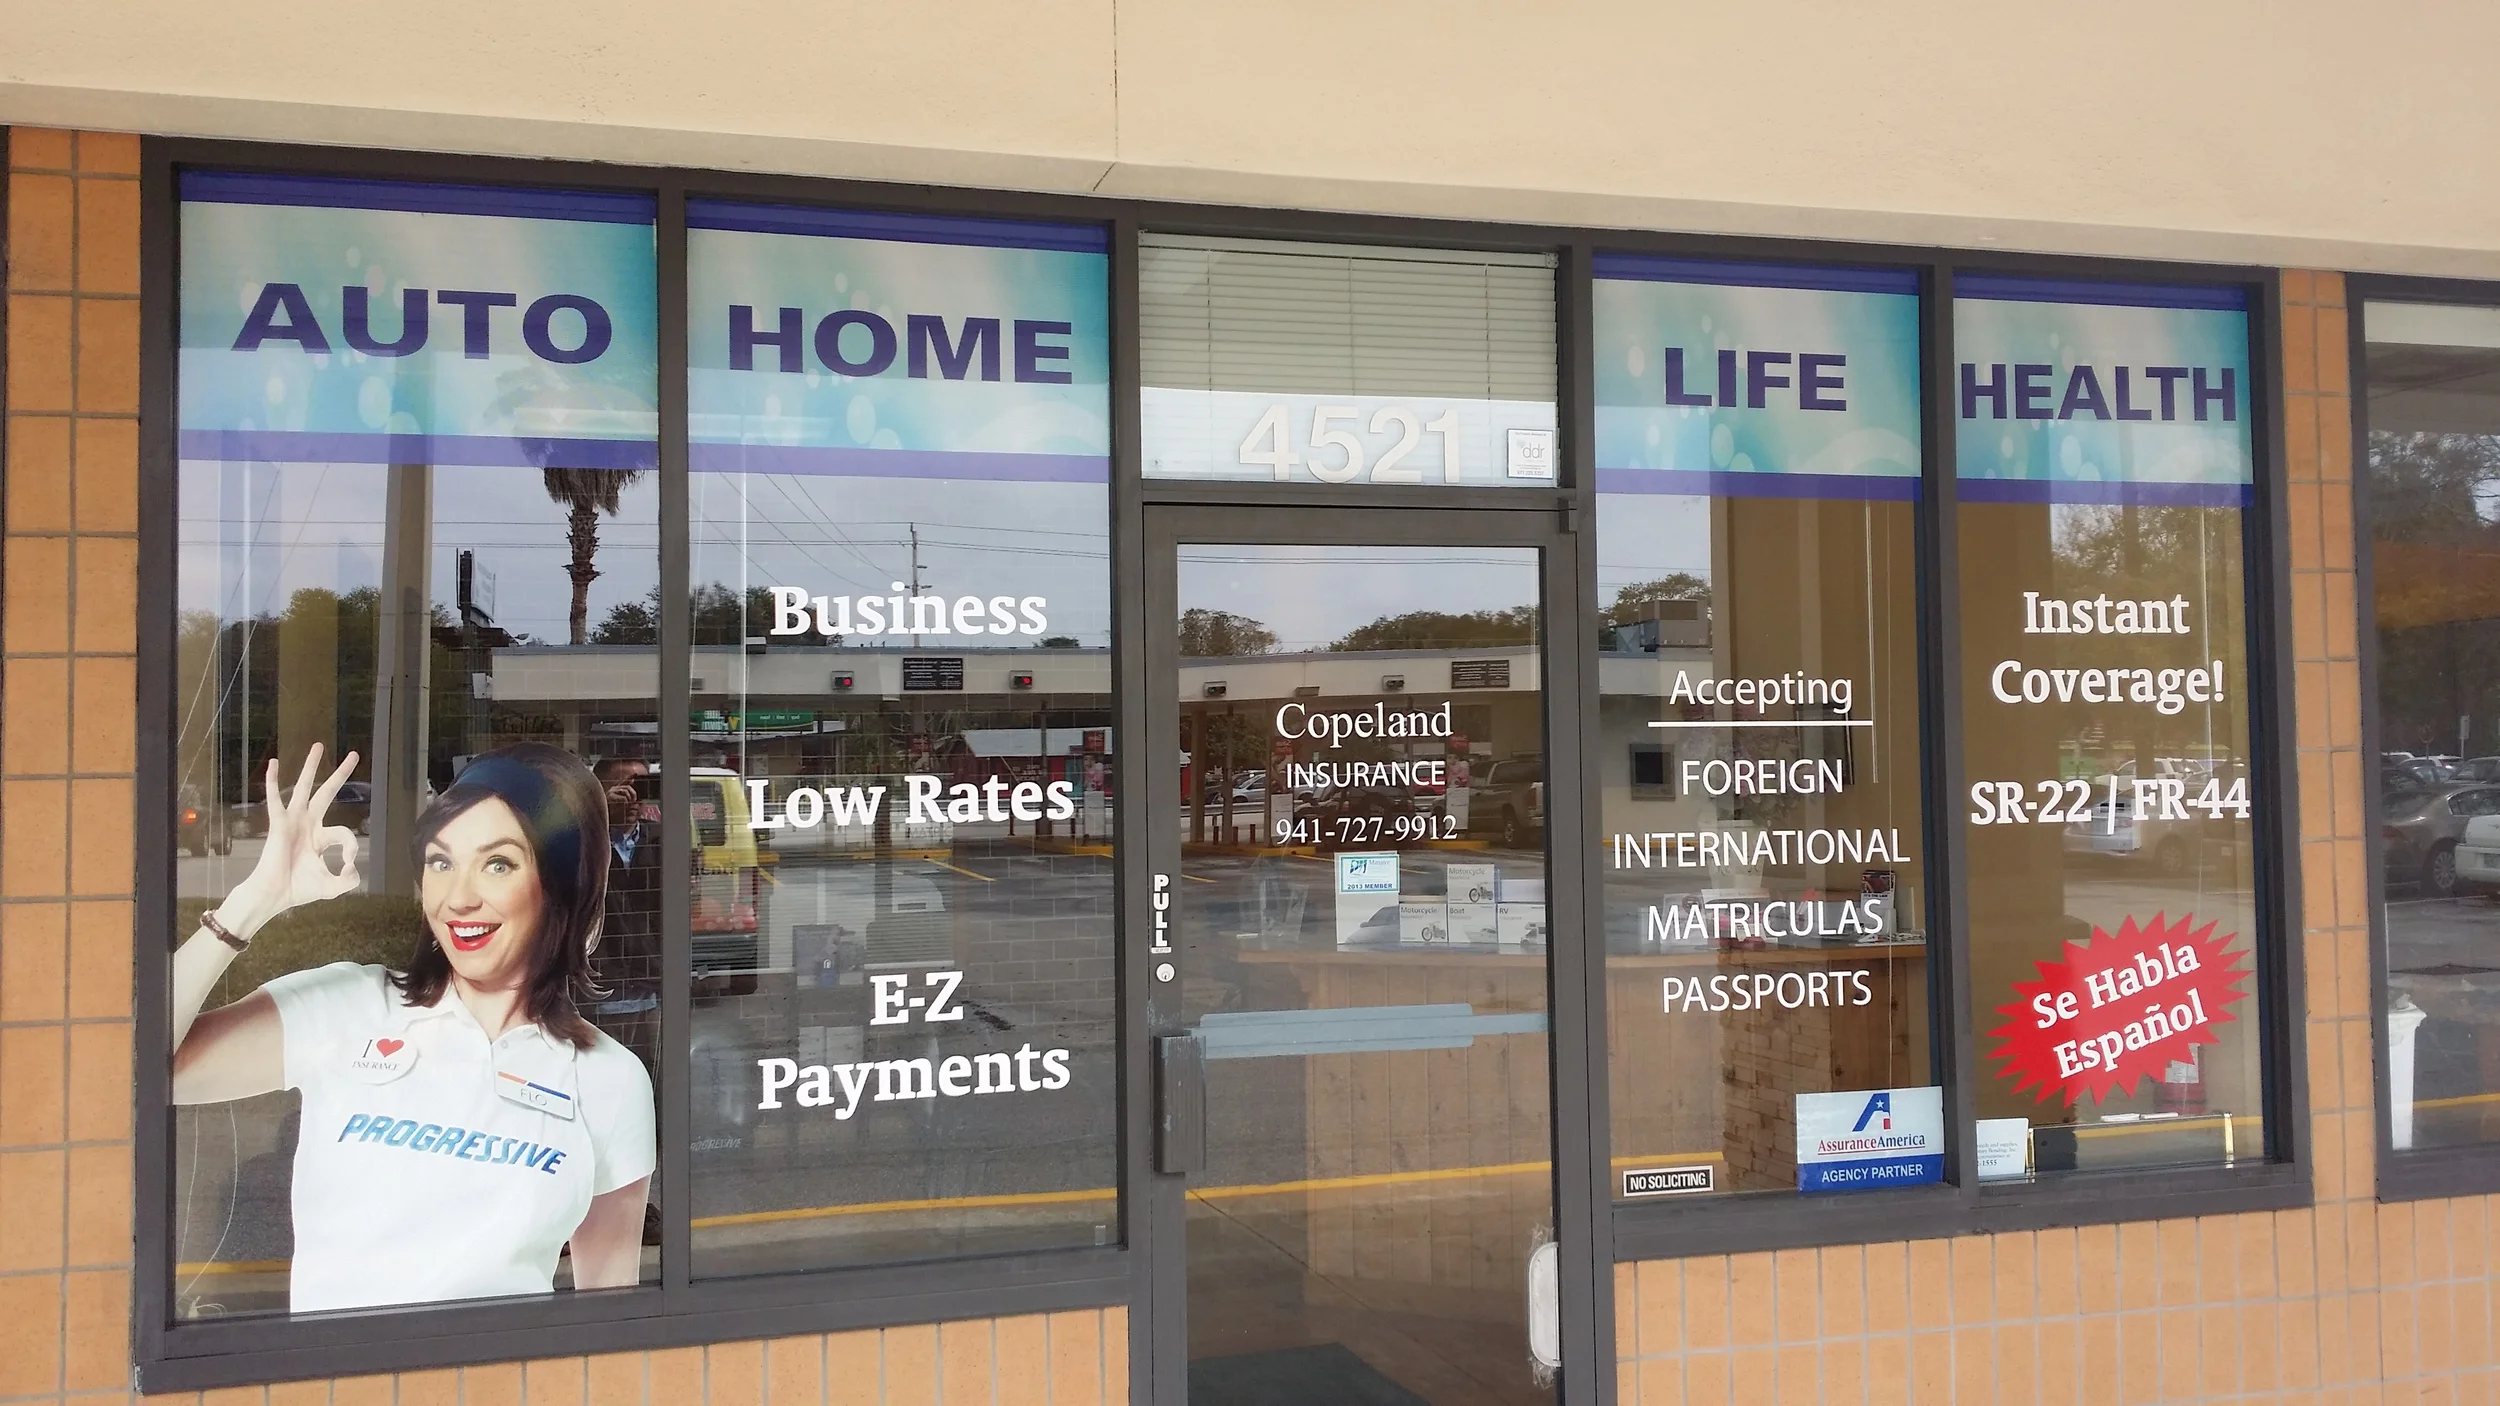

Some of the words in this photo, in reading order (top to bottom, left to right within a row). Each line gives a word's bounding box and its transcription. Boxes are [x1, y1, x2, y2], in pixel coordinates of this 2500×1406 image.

[231, 282, 613, 364] AUTO
[729, 304, 1073, 384] HOME
[1665, 347, 1847, 412] LIFE
[1960, 362, 2237, 422] HEALTH
[1239, 405, 1461, 484] 4521
[1522, 443, 1545, 458] ddr
[770, 581, 1048, 636] Business
[2023, 591, 2191, 634] Instant
[1669, 670, 1852, 714] Accepting
[1992, 660, 2225, 714] Coverage!
[1276, 701, 1454, 748] Copeland
[1286, 760, 1446, 788] INSURANCE
[1682, 758, 1843, 795] FOREIGN
[746, 779, 887, 829] Low
[904, 774, 1074, 824] Rates
[1971, 779, 2092, 825] SR-22
[2132, 777, 2251, 821] FR-44
[1276, 814, 1458, 845] 941-727-9912
[1614, 828, 1911, 869] INTERNATIONAL
[1448, 868, 1485, 876] Motorcycle
[1153, 874, 1170, 947] PULL
[1400, 907, 1438, 915] Motorcycle
[1647, 898, 1884, 941] MATRICULAS
[869, 970, 965, 1026] E-Z
[1662, 970, 1872, 1014] PASSPORTS
[2033, 992, 2080, 1029] Se
[2085, 942, 2201, 1009] Habla
[362, 1040, 373, 1058] I
[2053, 987, 2208, 1079] Español
[352, 1060, 401, 1072] INSURANCE
[757, 1042, 1072, 1121] Payments
[520, 1088, 548, 1107] FLO
[338, 1113, 567, 1176] PROGRESSIVE
[1818, 1134, 1926, 1153] AssuranceAmerica
[1630, 1176, 1648, 1190] NO
[1648, 1171, 1706, 1190] SOLICITING
[1821, 1167, 1870, 1184] AGENCY
[1871, 1163, 1924, 1180] PARTNER
